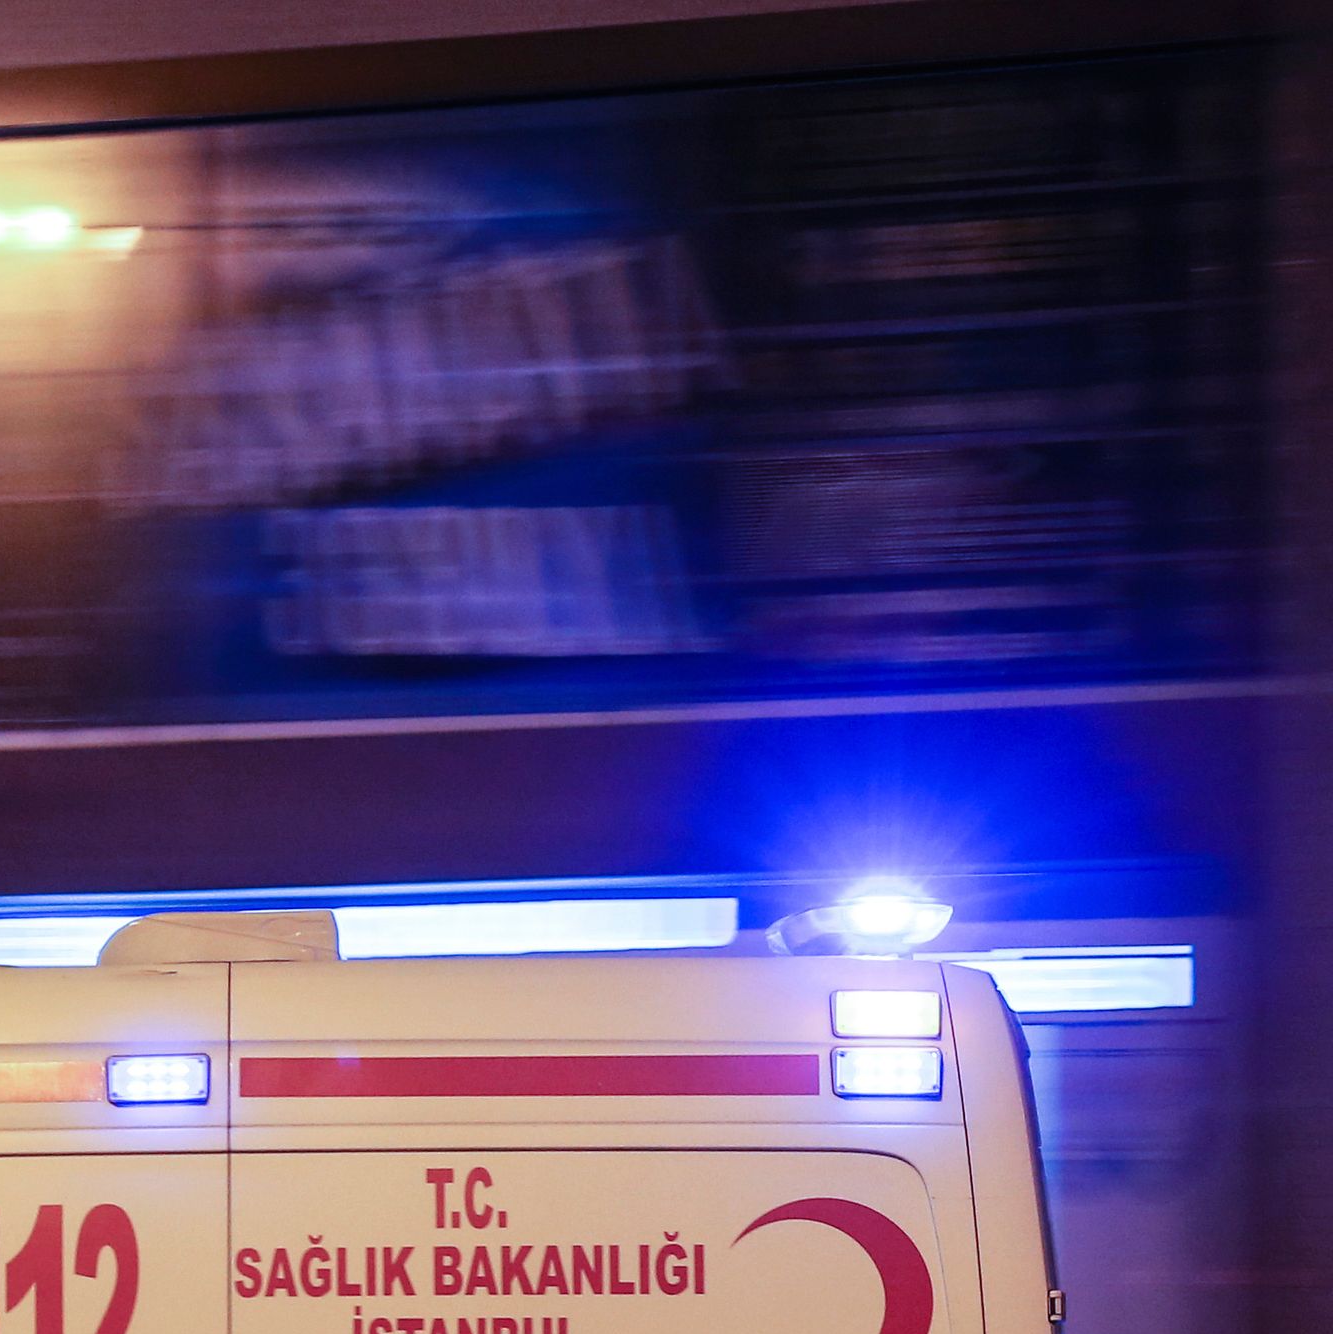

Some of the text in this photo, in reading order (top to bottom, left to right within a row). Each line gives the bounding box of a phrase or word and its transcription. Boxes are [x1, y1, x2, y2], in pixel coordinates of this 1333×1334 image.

[425, 1167, 509, 1230] T.C.
[235, 1231, 706, 1298] SAĞLIK BAKANLIĞI
